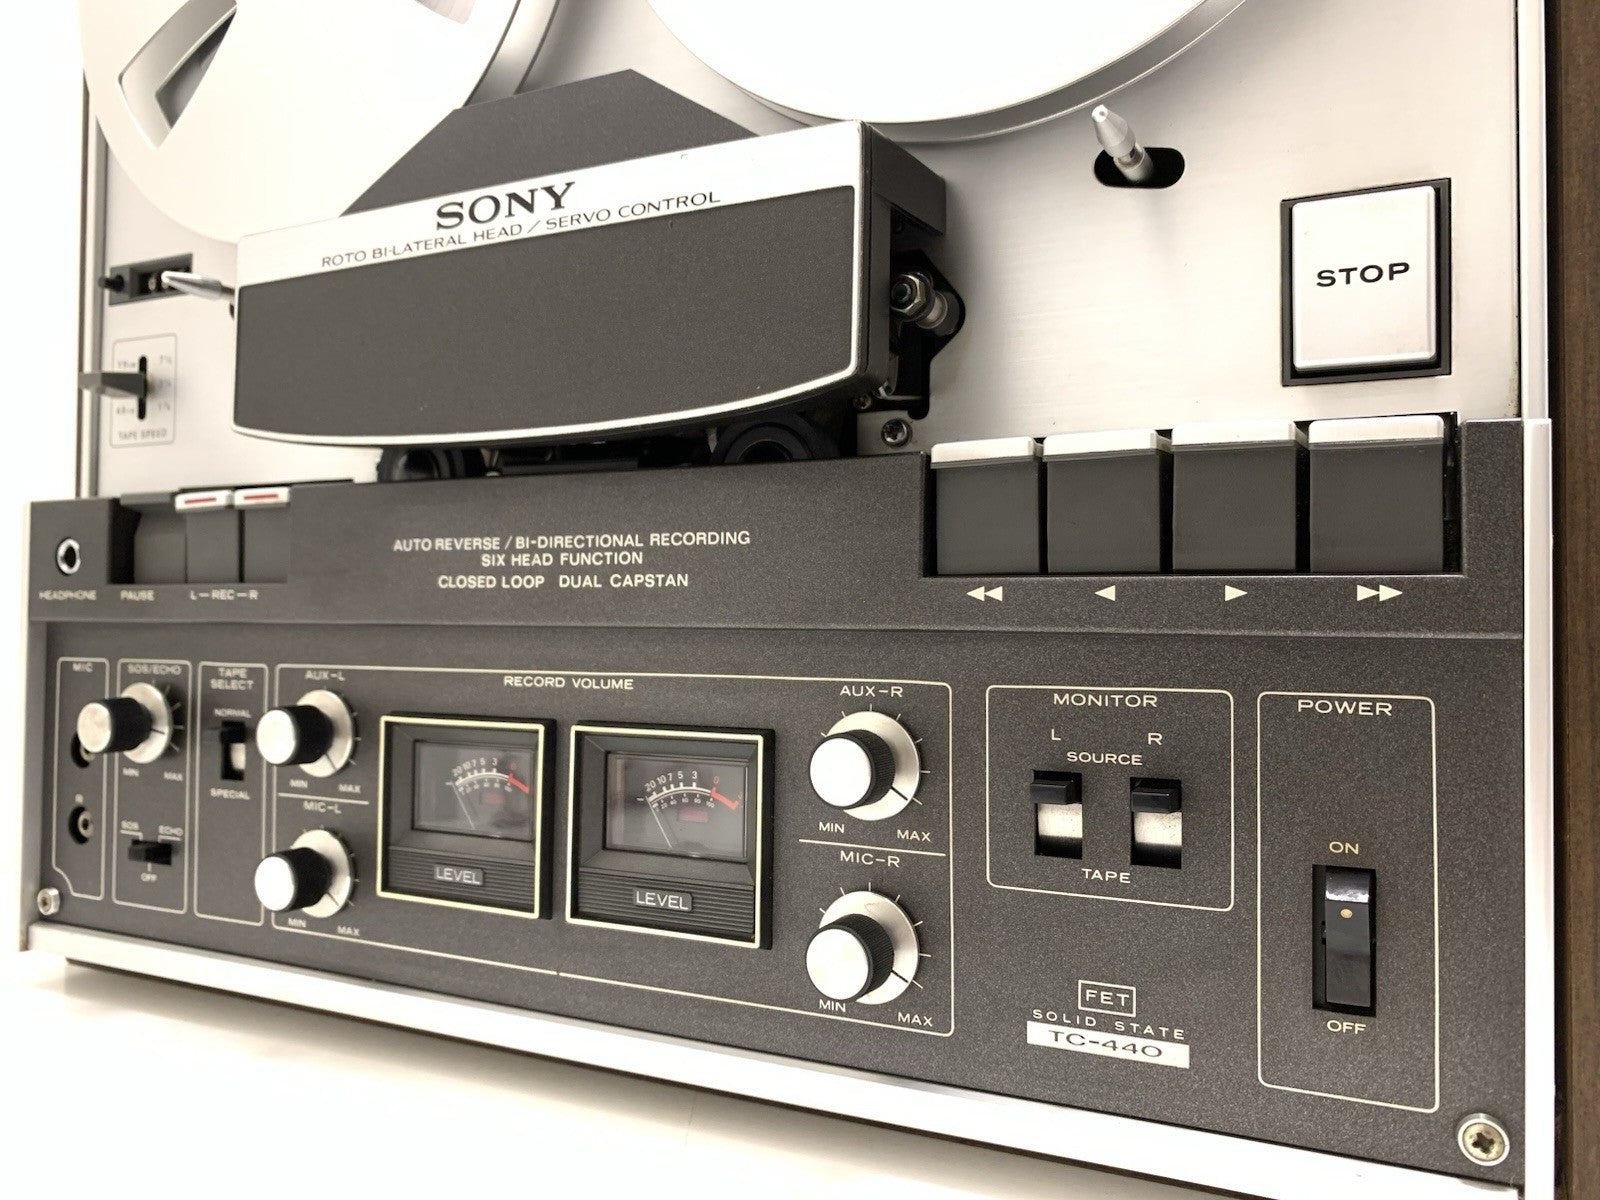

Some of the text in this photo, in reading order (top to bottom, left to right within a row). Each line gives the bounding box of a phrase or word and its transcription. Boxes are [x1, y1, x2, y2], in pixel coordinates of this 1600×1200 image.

[436, 182, 575, 231] SONY
[321, 250, 366, 268] ROTO
[372, 234, 466, 259] BI-LATERAL
[473, 223, 523, 242] HEAD
[546, 208, 611, 231] SERVO
[618, 191, 721, 219] CONTROL
[1316, 262, 1410, 287] STOP
[392, 538, 432, 552] AUTO
[435, 536, 501, 551] REVERSE
[515, 533, 643, 550] BI-DIRECTIONAL
[650, 530, 751, 547] RECORDING
[481, 551, 643, 567] SIX HEAD FUNCTION
[438, 573, 689, 589] CLOSED LOOP DUAL CAPSTAN
[38, 590, 97, 601] HEADPHONE
[119, 589, 155, 601] PAUSE
[72, 662, 93, 673] MIC
[218, 667, 248, 679] TAPE
[304, 670, 346, 682] AUX-L
[504, 675, 635, 690] RECORD VOLUME
[210, 679, 254, 691] SELECT
[839, 685, 904, 699] AUX-R
[1053, 693, 1158, 708] MONITOR
[1297, 699, 1393, 716] POWER
[214, 707, 251, 719] NORMAL
[1051, 728, 1062, 741] L
[1147, 732, 1163, 746] R
[1066, 751, 1143, 766] SOURCE
[123, 767, 140, 777] MIN
[164, 771, 184, 782] MAX
[290, 779, 308, 789] MIN
[339, 783, 361, 794] MAX
[645, 780, 657, 792] 20
[656, 775, 667, 785] 10
[667, 773, 673, 782] 7
[677, 771, 684, 779] 5
[691, 771, 698, 780] 3
[210, 788, 251, 800] SPECIAL
[303, 800, 343, 814] MIC-L
[158, 825, 183, 836] ECHO
[818, 822, 845, 834] MIN
[896, 829, 932, 842] MAX
[1329, 841, 1360, 855] ON
[840, 850, 901, 868] MIC-R
[141, 872, 158, 882] OFF
[436, 867, 481, 885] LEVEL
[1081, 868, 1132, 884] TAPE
[635, 891, 690, 910] LEVEL
[288, 917, 307, 928] MIN
[336, 925, 361, 937] MAX
[1085, 989, 1130, 1007] FET
[818, 998, 846, 1013] MIN
[897, 1011, 933, 1027] MAX
[1032, 1009, 1186, 1040] SOLID STATE
[1326, 1019, 1367, 1035] OFF
[1048, 1028, 1163, 1059] TC-440
